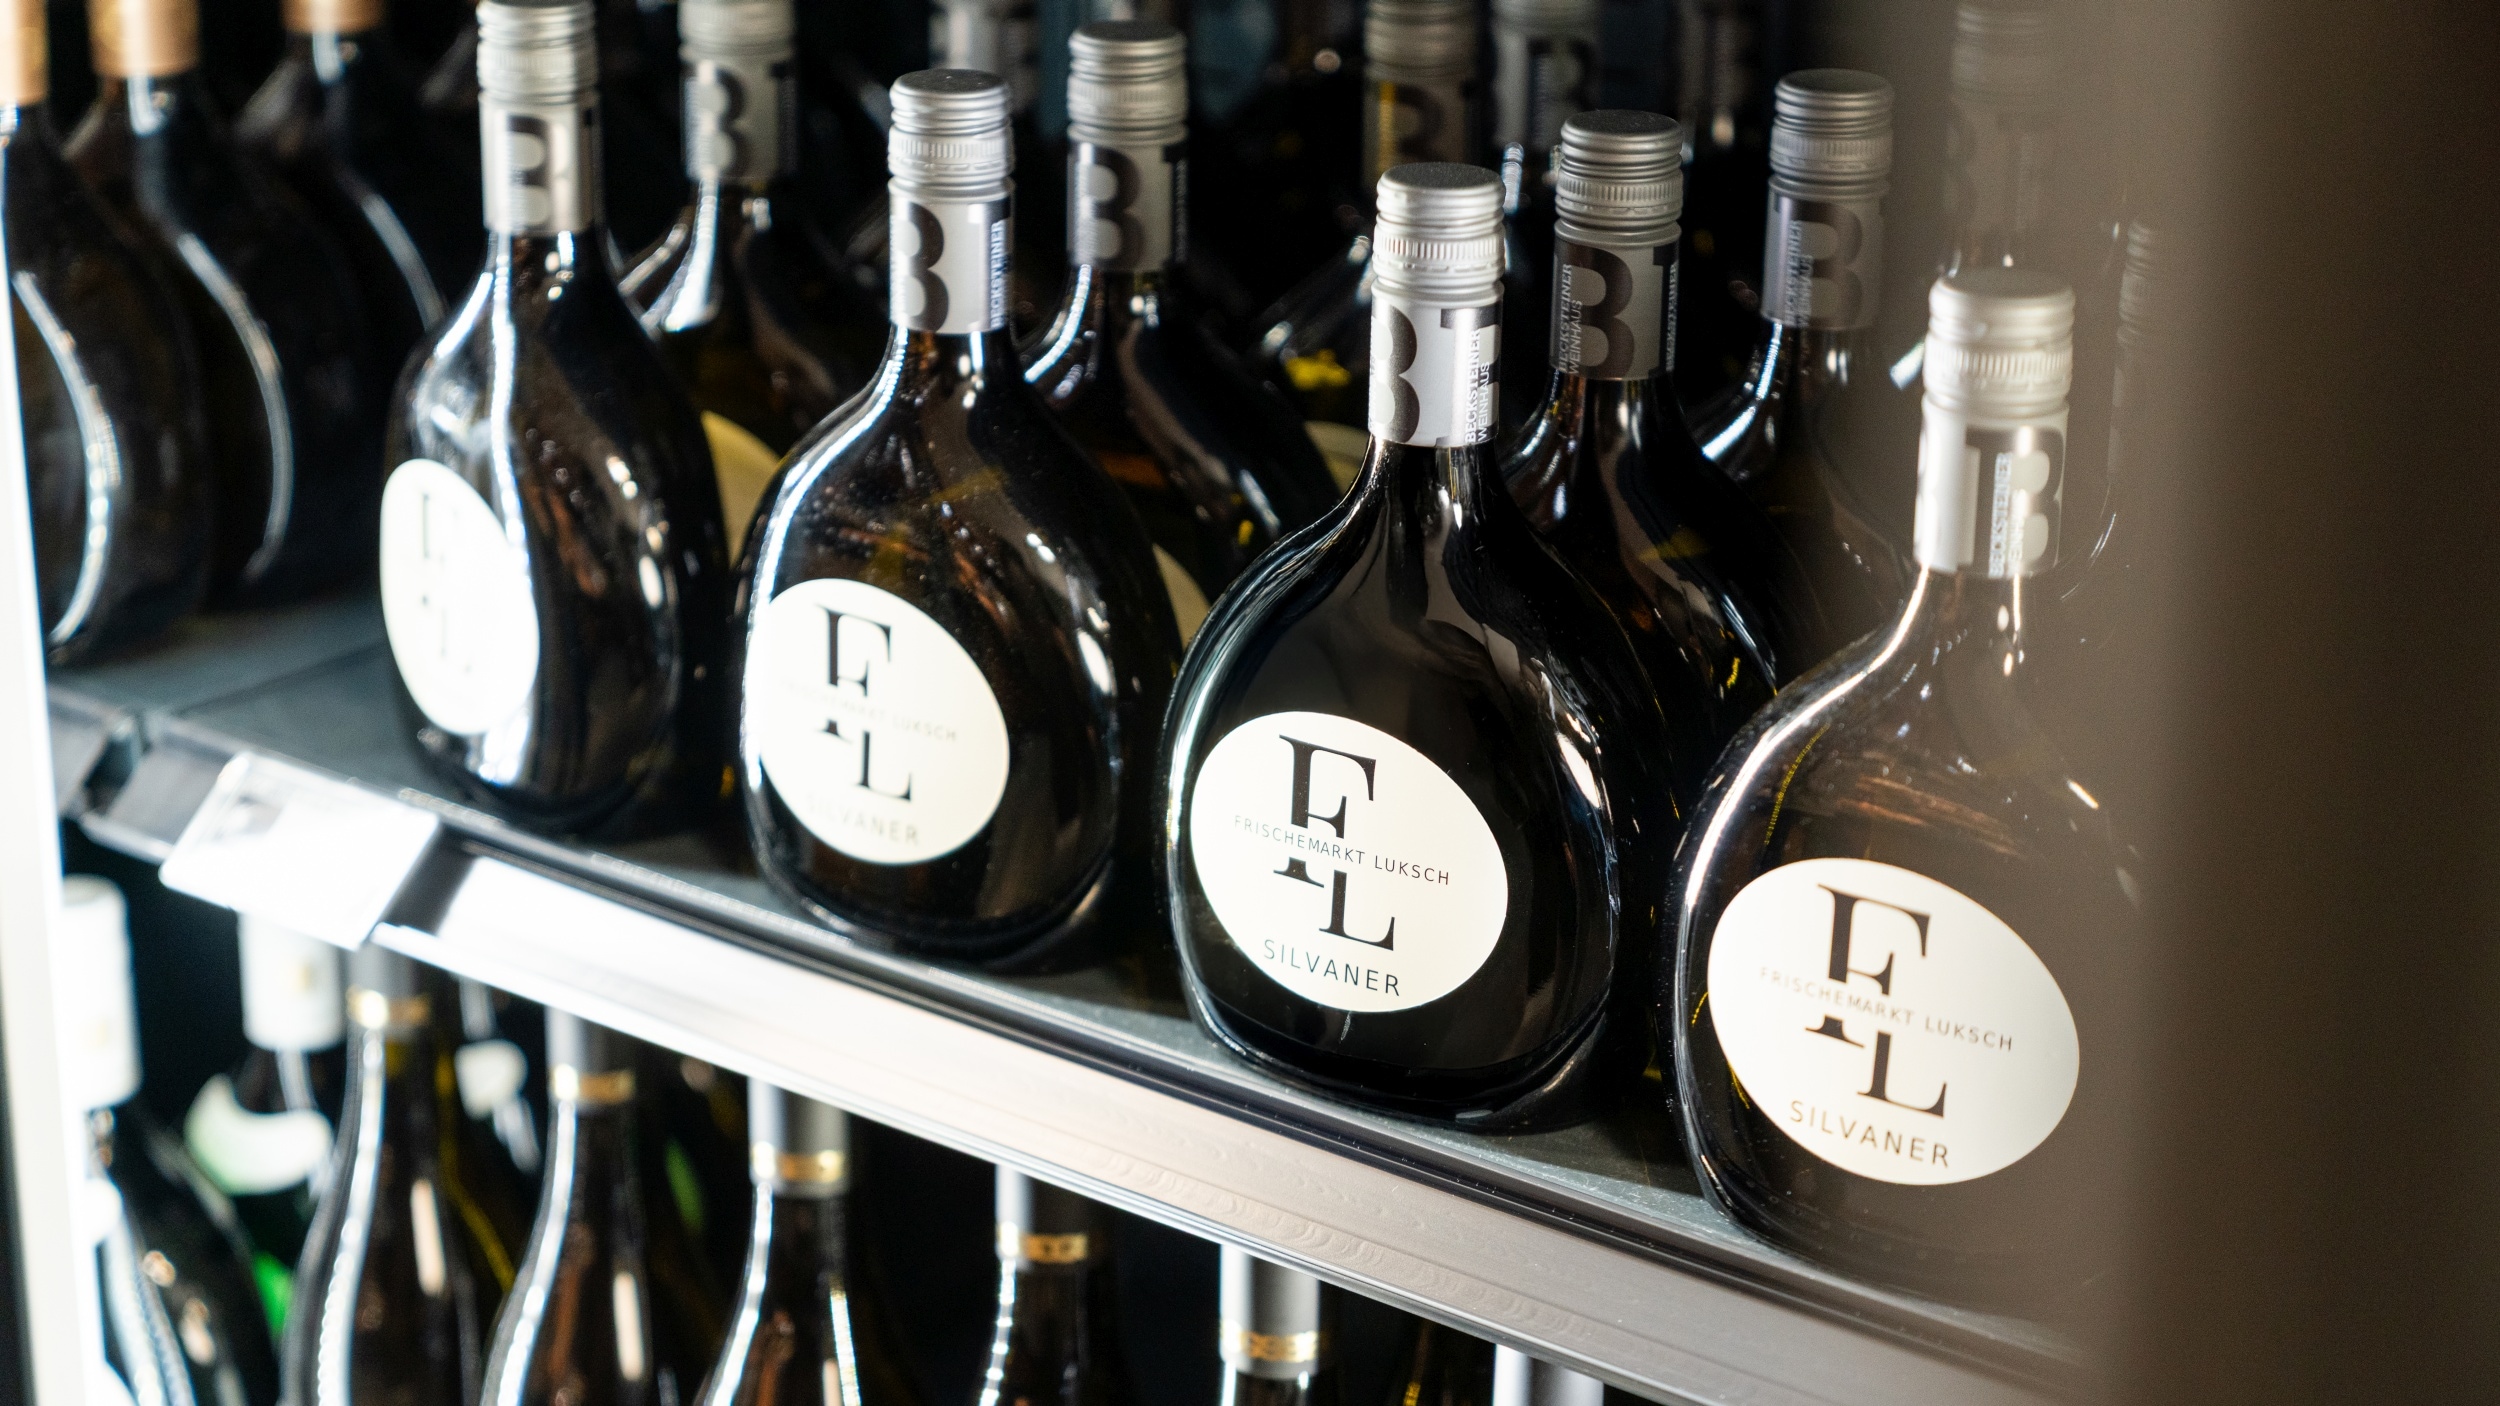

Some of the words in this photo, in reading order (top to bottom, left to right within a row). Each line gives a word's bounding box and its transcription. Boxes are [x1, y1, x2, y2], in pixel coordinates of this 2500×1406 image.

[1558, 263, 1573, 374] BECKSTEINER
[1568, 299, 1583, 374] WEINHAUS
[1465, 328, 1481, 443] BECKSTEINER
[1477, 361, 1490, 441] WEINHAUS
[892, 713, 958, 743] LUKSCH
[805, 793, 919, 847] SILVANER
[1234, 814, 1366, 866] FRISCHEMARKT
[1374, 854, 1450, 886] LUKSCH
[1262, 938, 1401, 997] SILVANER
[1760, 966, 1916, 1027] FRISCHEMARKT
[1924, 1015, 2014, 1053] LUKSCH
[1789, 1100, 1950, 1169] SILVANER
